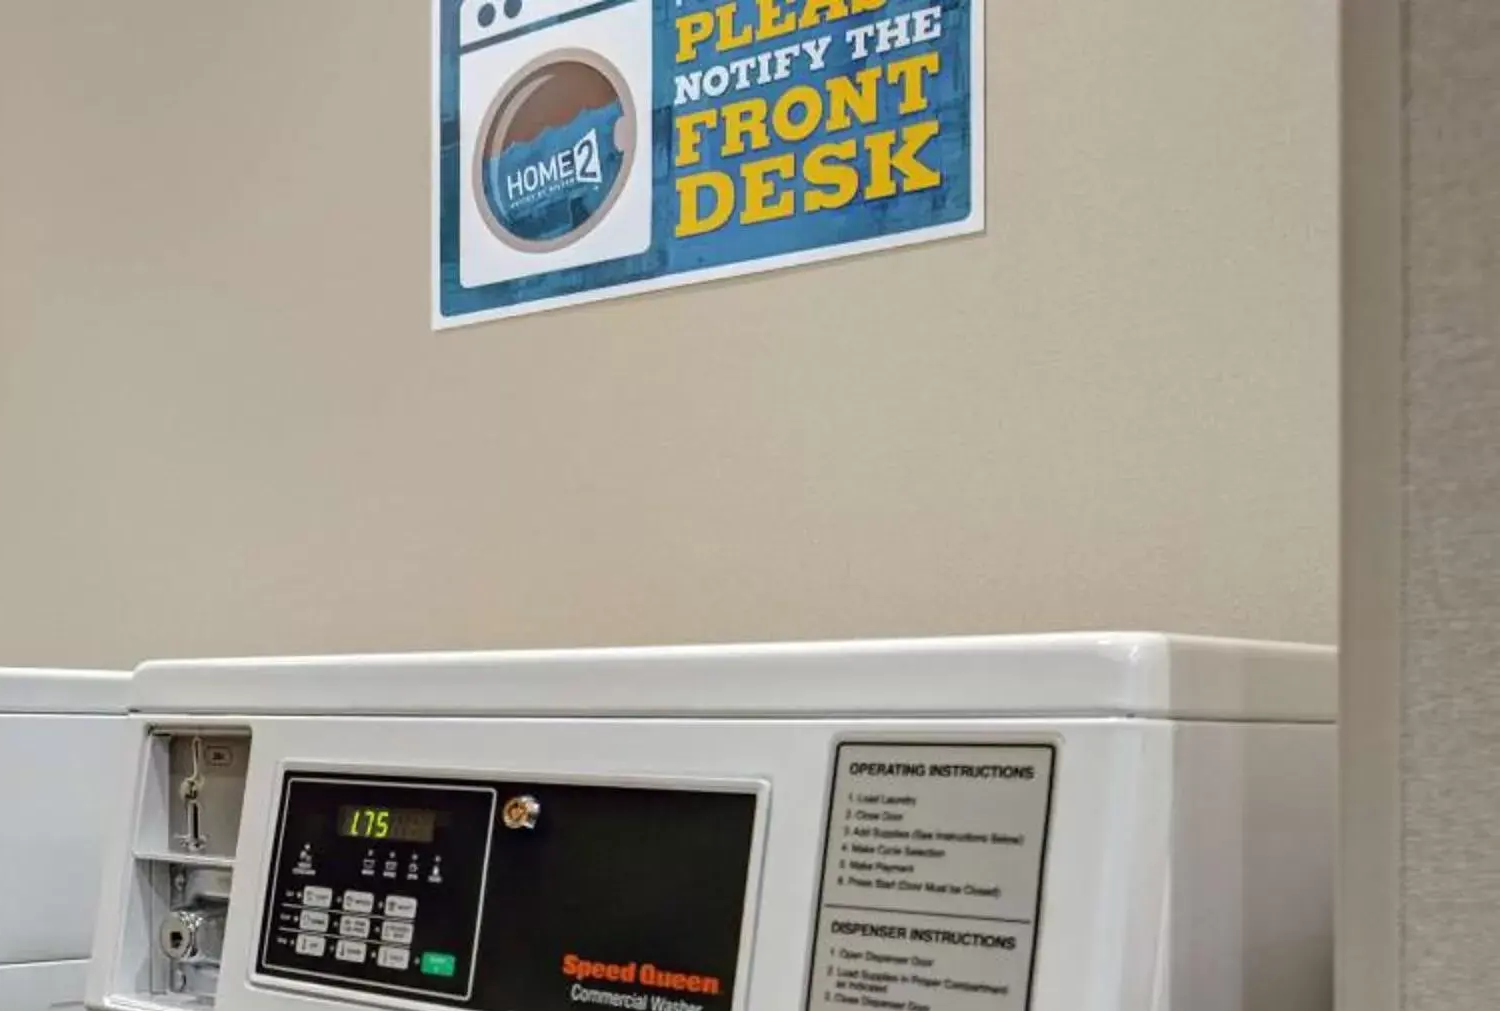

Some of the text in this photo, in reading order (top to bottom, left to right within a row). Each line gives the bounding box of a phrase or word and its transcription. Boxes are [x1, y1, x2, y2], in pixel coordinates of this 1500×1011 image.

[673, 5, 942, 107] NOTIFY THE
[673, 52, 940, 168] FRONT
[673, 120, 942, 239] DESK
[849, 761, 1036, 780] OPERATING INSTRUCTIONS
[831, 920, 1017, 951] DISPENSER INSTRUCTIONS
[562, 952, 720, 995] Speed Queen
[570, 982, 647, 1011] Commercial
